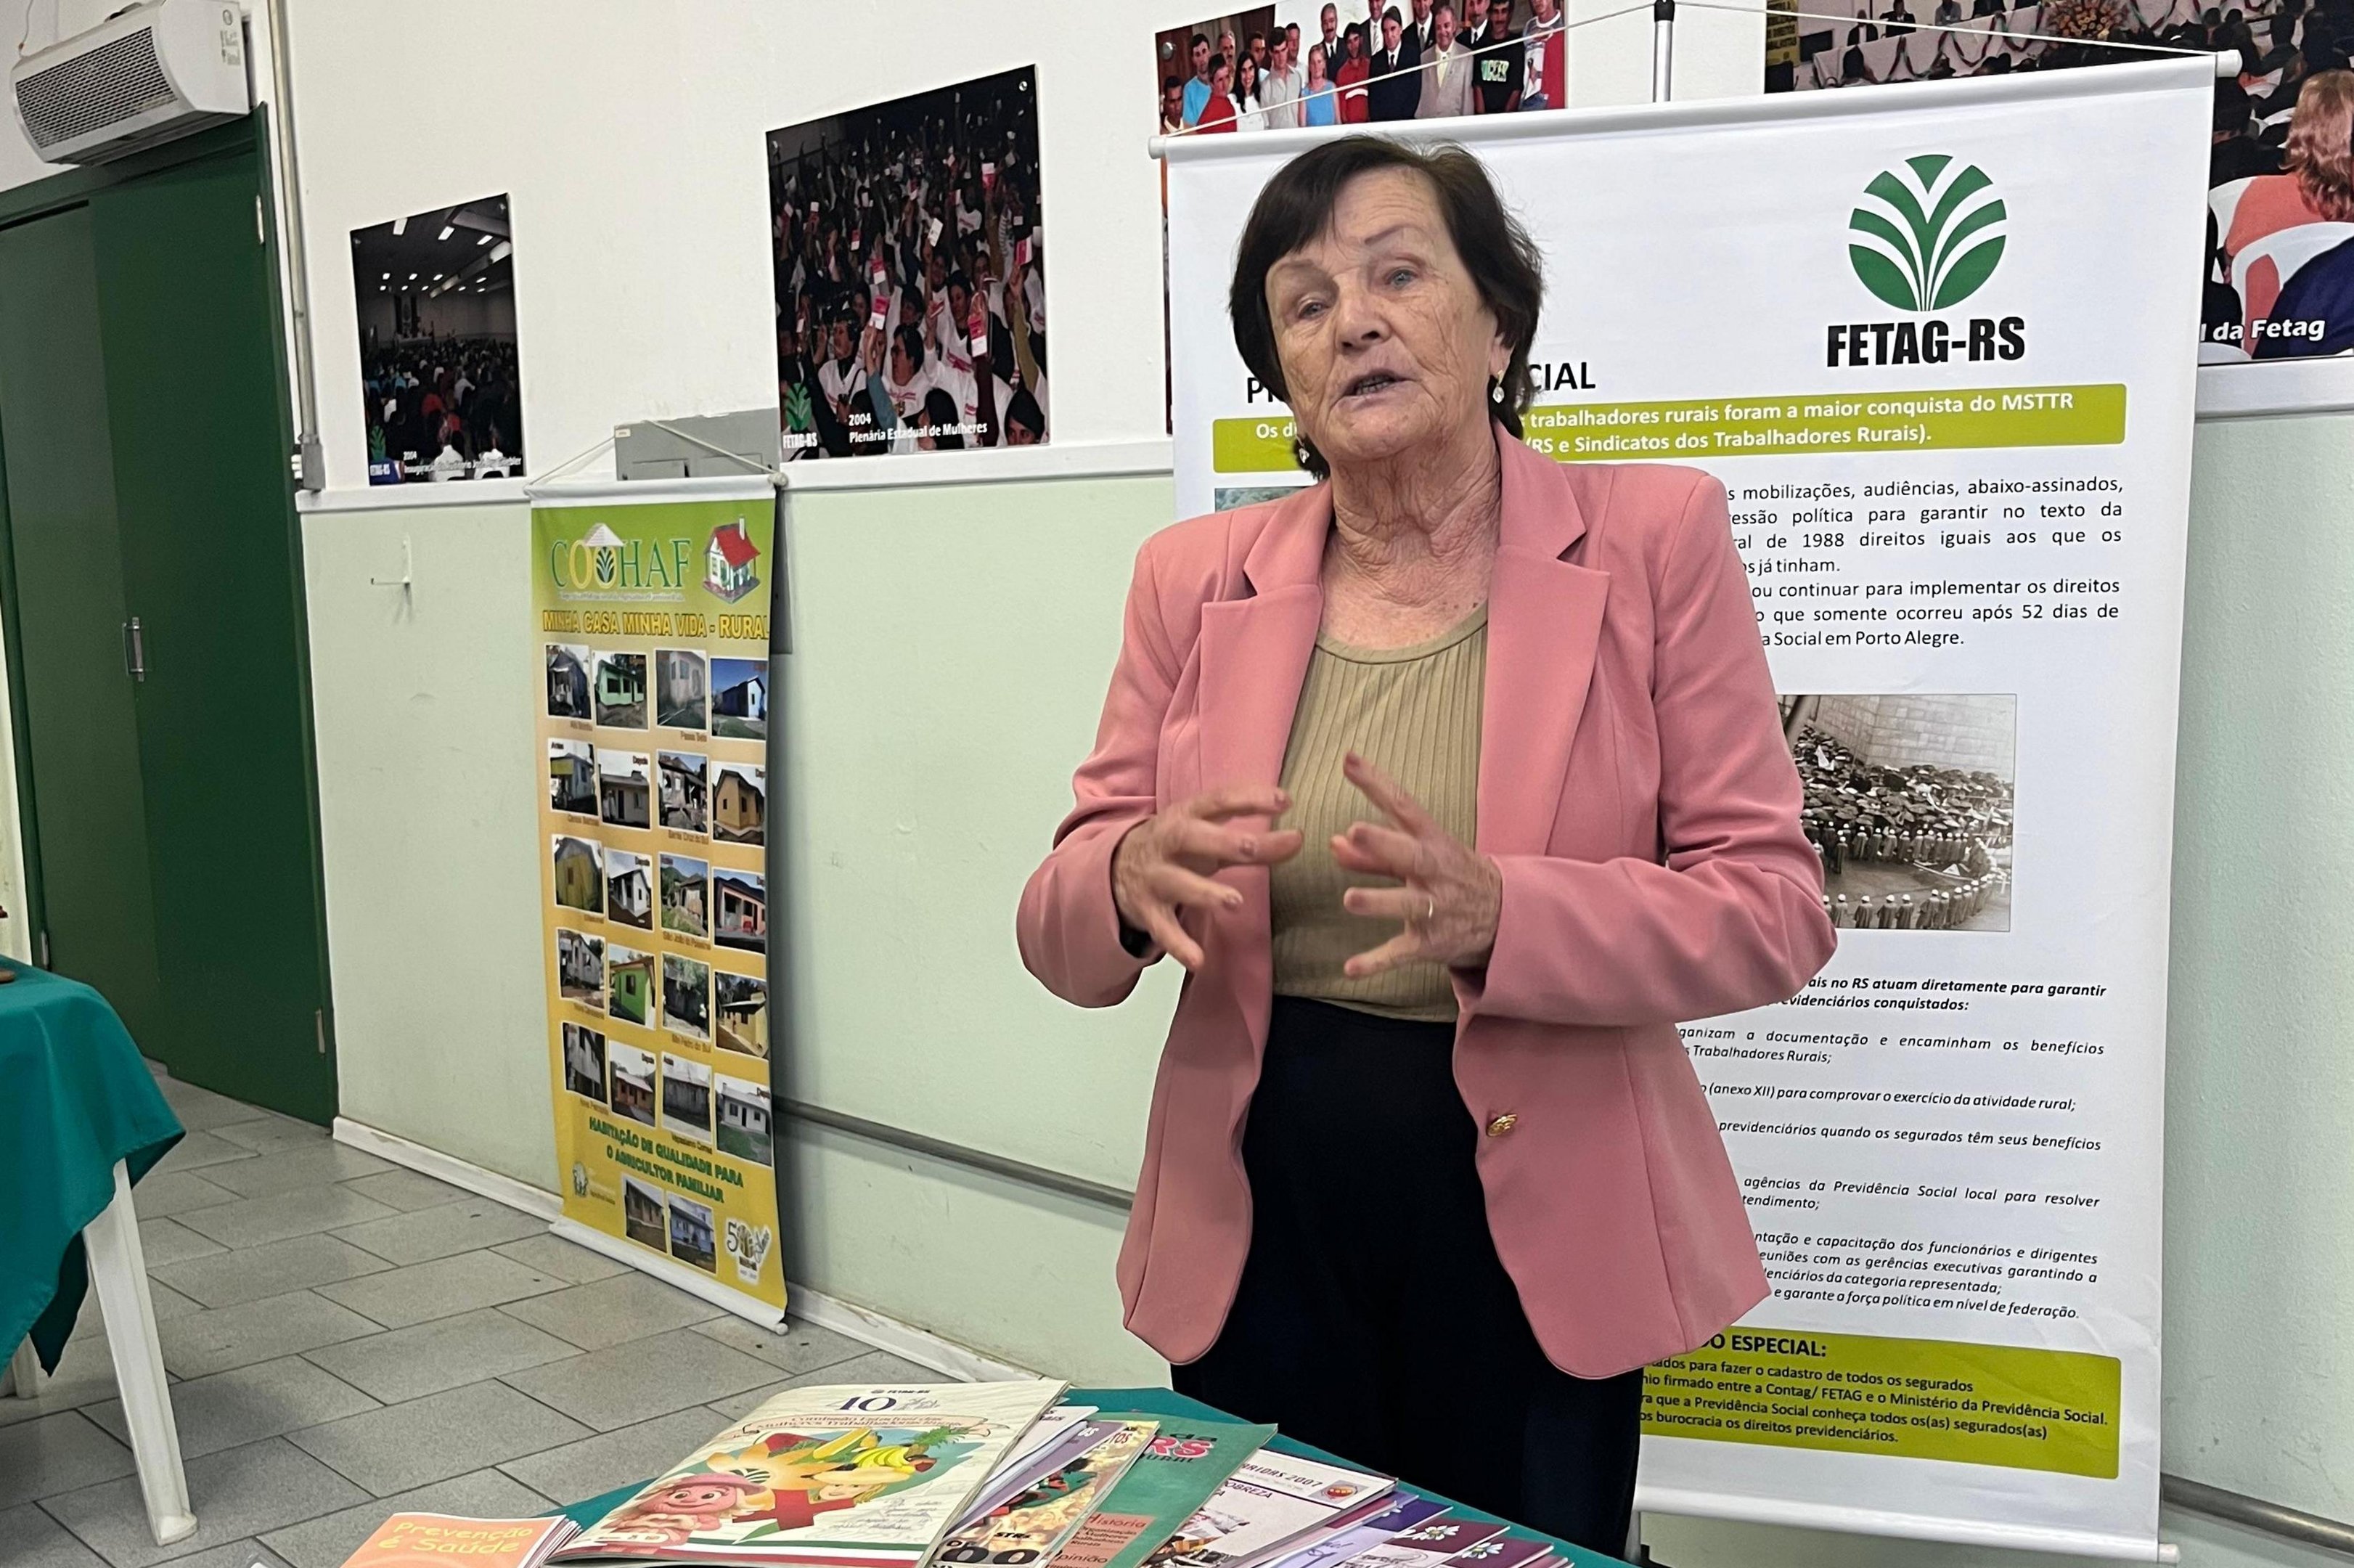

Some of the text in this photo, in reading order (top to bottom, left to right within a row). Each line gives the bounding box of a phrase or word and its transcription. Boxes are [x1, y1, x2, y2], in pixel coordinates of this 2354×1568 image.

[1826, 317, 2024, 367] FETAG-RS
[2213, 319, 2326, 341] da Fetag
[849, 413, 871, 426] 2004
[1530, 392, 2073, 428] trabalhadores rurais foram maior conquista do MSTTR
[849, 422, 988, 444] Plenária Estadual de Mulheres
[1256, 423, 1278, 438] Os
[1574, 423, 1931, 452] Sindicatos dos Trabalhadores Rurais).
[1744, 475, 2122, 502] mobilizações, audiências, abaixo-assinados,
[1792, 501, 2122, 526] política para garantir no texto da
[1767, 529, 2121, 548] de 1988 direitos iguais aos que os
[1757, 558, 1839, 576] já tinham.
[1779, 578, 2120, 599] continuar para implementar os direitos
[543, 610, 769, 640] MINHA CASA MINHA VIDA RURAL
[1773, 603, 2118, 624] que somente ocorreu após 52 dias de
[1774, 629, 1963, 648] Social em Porto Alegre.
[1831, 977, 2106, 997] no RS atuam diretamente para garantir
[1873, 997, 1969, 1010] conquistados:
[1693, 1045, 1831, 1064] Trabalhadores Rurais;
[1766, 1030, 2104, 1055] documentação encaminham os benefícios
[1709, 1082, 2075, 1111] (anexo XII) para comprovar exercício da atividade rural;
[1719, 1122, 2101, 1151] previdenciários quando os segurados têm seus benefícios
[606, 1145, 613, 1159] O
[642, 1138, 653, 1155] DE
[714, 1164, 744, 1188] PARA
[1744, 1176, 2100, 1206] agências da Previdência Social local para resolver
[1816, 1237, 2097, 1264] capacitação dos funcionários dirigentes
[1813, 1255, 2083, 1281] com gerências executivas garantindo
[1826, 1271, 2001, 1295] da categoria representada;
[1783, 1289, 2078, 1319] garante força política em nível de federação.
[1732, 1334, 1826, 1357] ESPECIAL:
[1689, 1361, 1717, 1372] para
[1720, 1360, 1752, 1375] fazer
[1767, 1365, 1823, 1380] cadastro
[1826, 1370, 1842, 1381] de
[1846, 1372, 1883, 1384] todos
[1887, 1376, 1902, 1386] os
[1905, 1378, 1973, 1392] segurados
[1664, 1373, 1714, 1389] firmado
[1717, 1381, 1752, 1393] entre
[1765, 1383, 1818, 1400] Contag/
[1822, 1387, 1862, 1402] FETAG
[1890, 1393, 1958, 1409] Ministério
[1961, 1398, 1977, 1410] da
[1982, 1400, 2059, 1419] Previdência
[2064, 1409, 2107, 1425] Social.
[1656, 1396, 1680, 1407] que
[1695, 1397, 1767, 1413] Previdência
[1771, 1402, 1808, 1417] Social
[1812, 1408, 1866, 1424] conheça
[1870, 1412, 1908, 1425] todos
[1910, 1415, 1950, 1430] os(as)
[1953, 1421, 2047, 1440] segurados(as)
[1656, 1410, 1722, 1427] burocracia
[1744, 1418, 1791, 1433] direitos
[1796, 1425, 1898, 1442] previdenciários.
[1285, 1474, 1323, 1487] 2007
[393, 1522, 534, 1540] Prevenção
[377, 1535, 520, 1554] é Saúde
